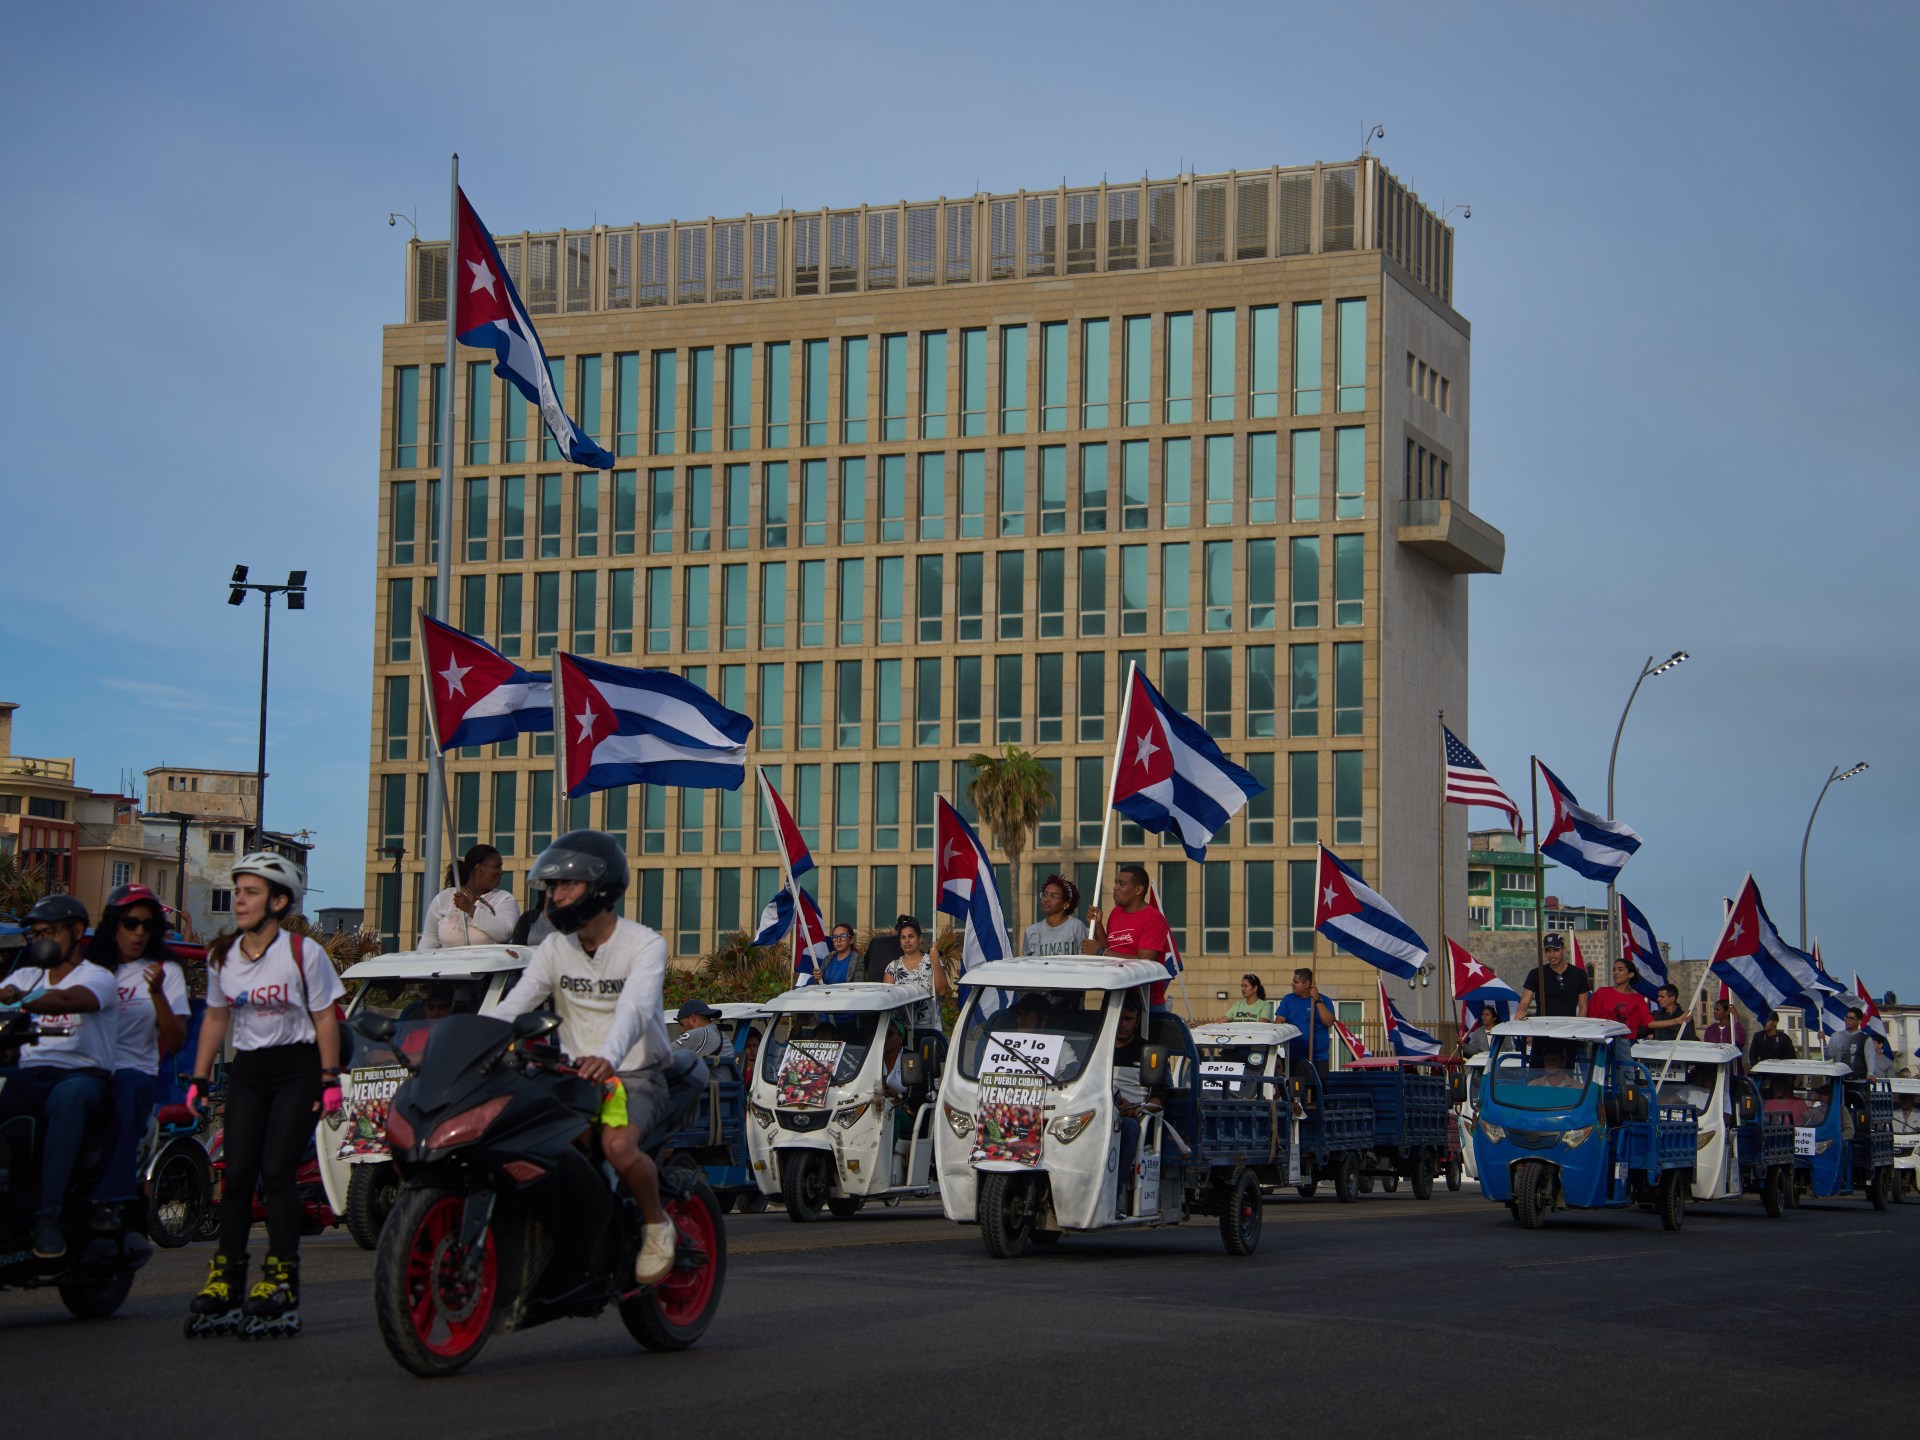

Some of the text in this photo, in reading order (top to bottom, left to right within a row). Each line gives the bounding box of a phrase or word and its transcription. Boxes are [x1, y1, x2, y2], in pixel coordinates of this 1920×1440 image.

[117, 987, 137, 1001] RI
[250, 982, 289, 1008] ISRI
[1031, 1039, 1046, 1050] lo
[990, 1053, 1050, 1065] que sea
[364, 1069, 384, 1081] PUEBLO
[384, 1068, 408, 1079] CUBANO
[993, 1075, 1017, 1086] PUEBLO
[1018, 1077, 1043, 1088] CUBANO
[982, 1086, 1042, 1106] VENCERÁ!
[1794, 1146, 1809, 1154] DIE
